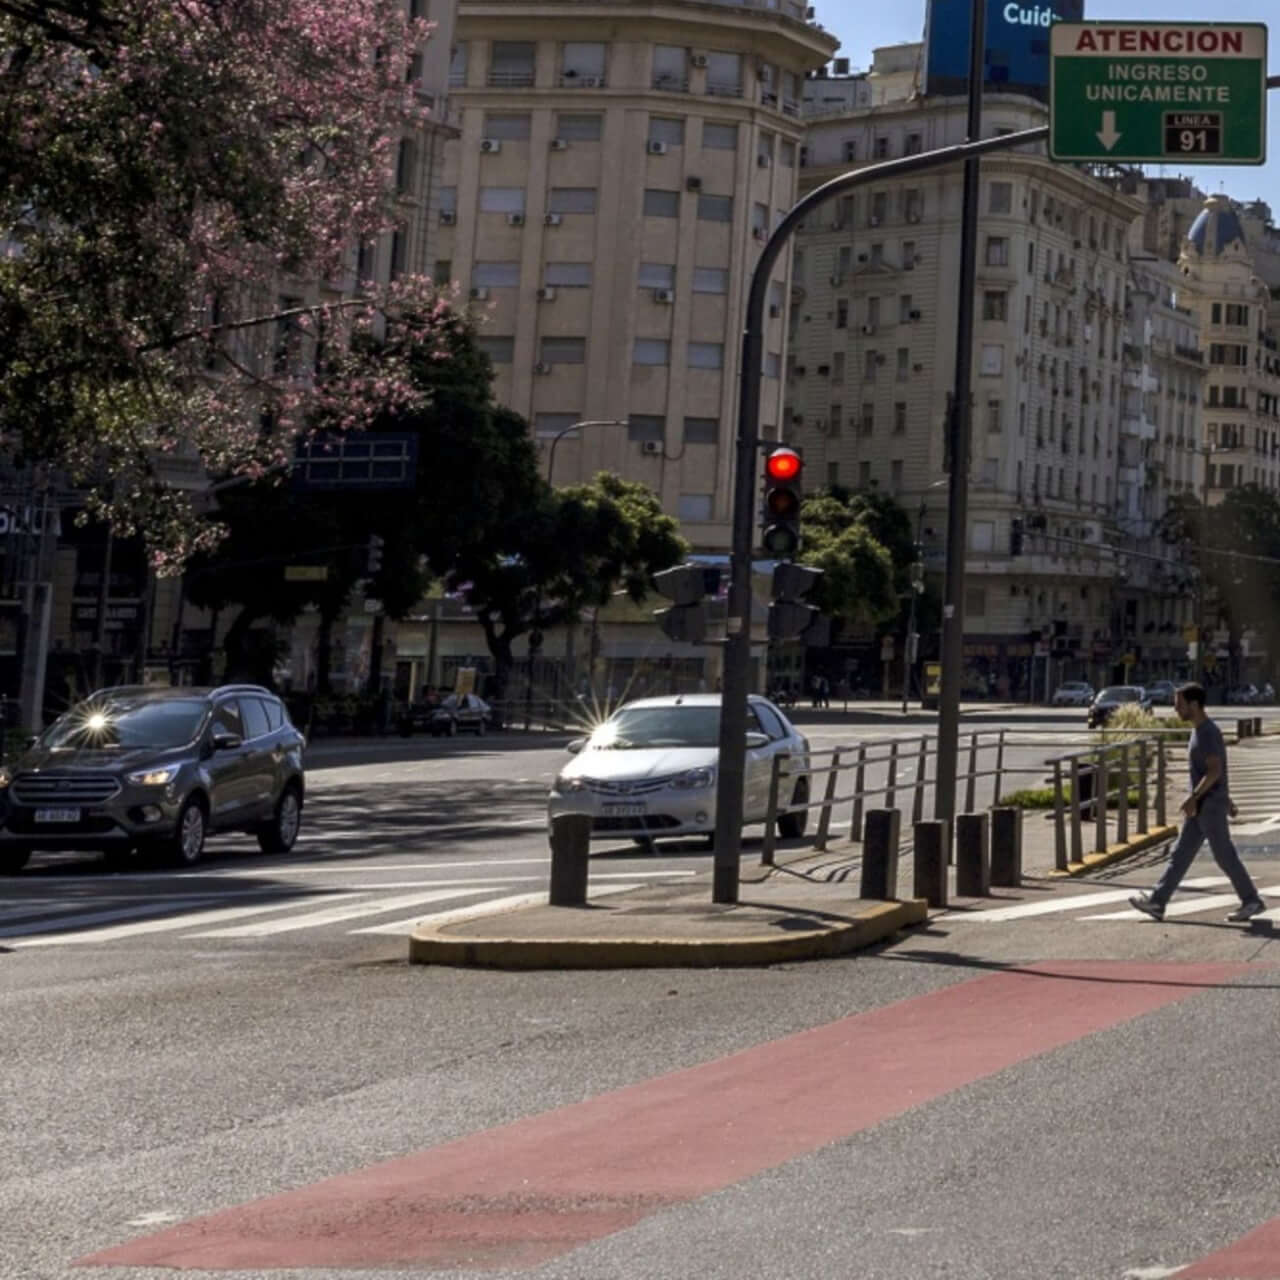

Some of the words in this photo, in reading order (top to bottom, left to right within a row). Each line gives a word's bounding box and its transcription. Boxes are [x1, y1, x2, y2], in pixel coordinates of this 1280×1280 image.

[1003, 2, 1062, 26] Cuid
[1076, 29, 1243, 53] ATENCION
[1108, 64, 1208, 82] INGRESO
[1086, 85, 1231, 103] UNICAMENTE
[1173, 114, 1211, 126] LINEA
[1180, 131, 1209, 151] 91
